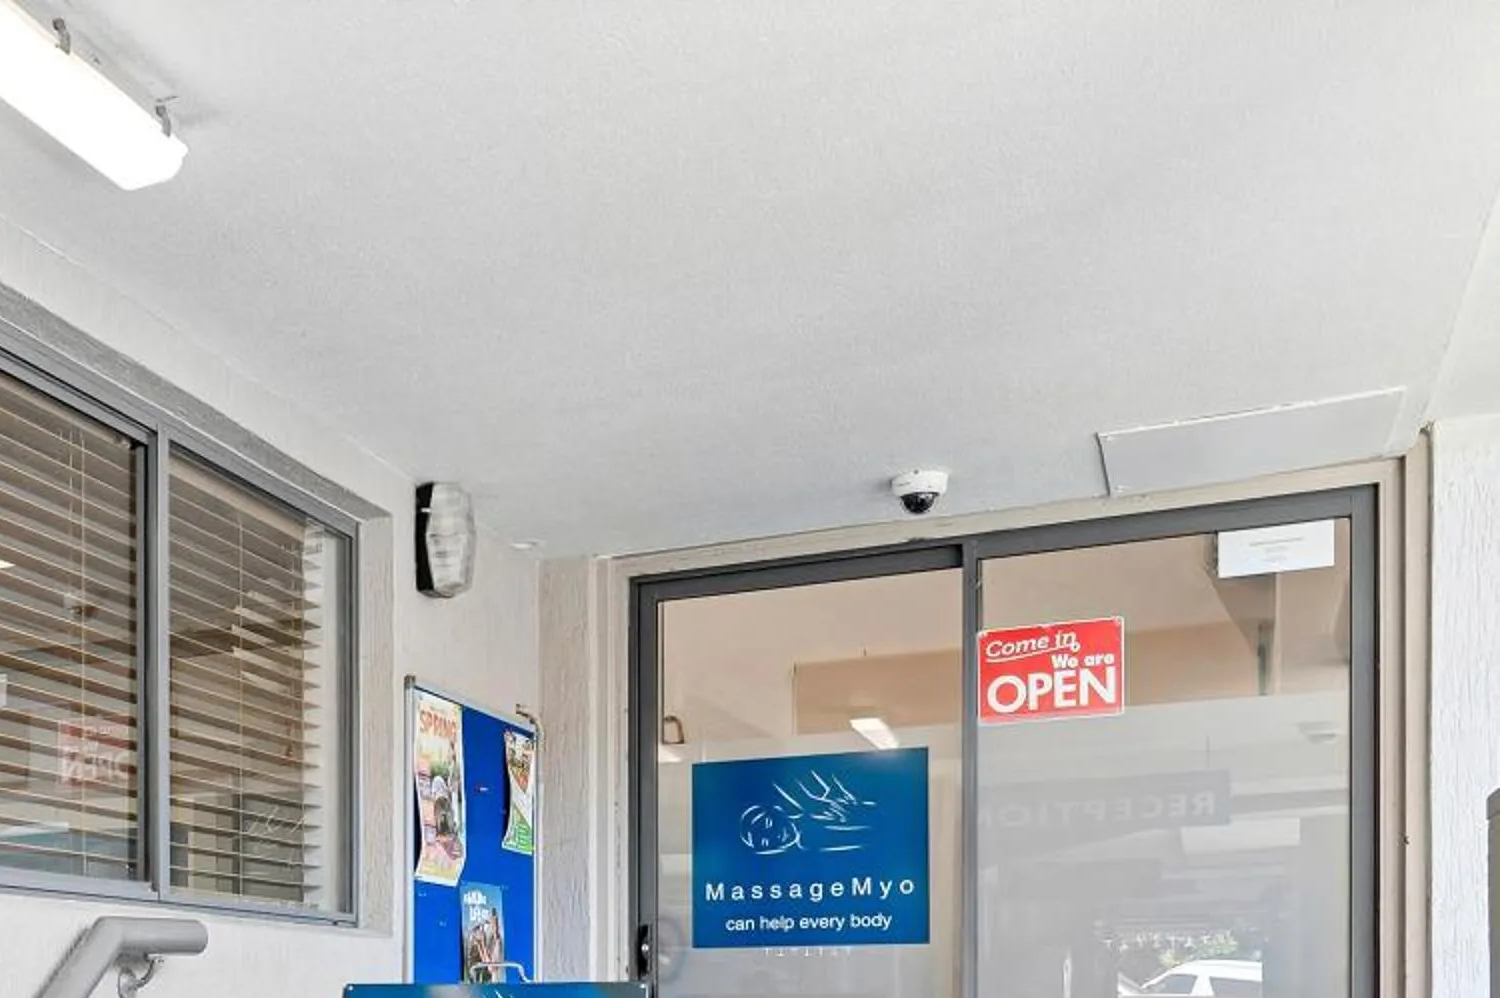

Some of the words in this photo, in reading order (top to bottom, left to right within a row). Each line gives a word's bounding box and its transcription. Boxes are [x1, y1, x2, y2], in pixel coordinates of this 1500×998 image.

[986, 636, 1050, 657] Come
[1051, 655, 1078, 668] We
[1084, 653, 1115, 666] are
[987, 667, 1116, 713] OPEN
[705, 877, 915, 902] MassageMyo
[725, 917, 755, 931] can
[760, 915, 794, 932] help
[799, 916, 845, 932] every
[850, 912, 893, 929] body
